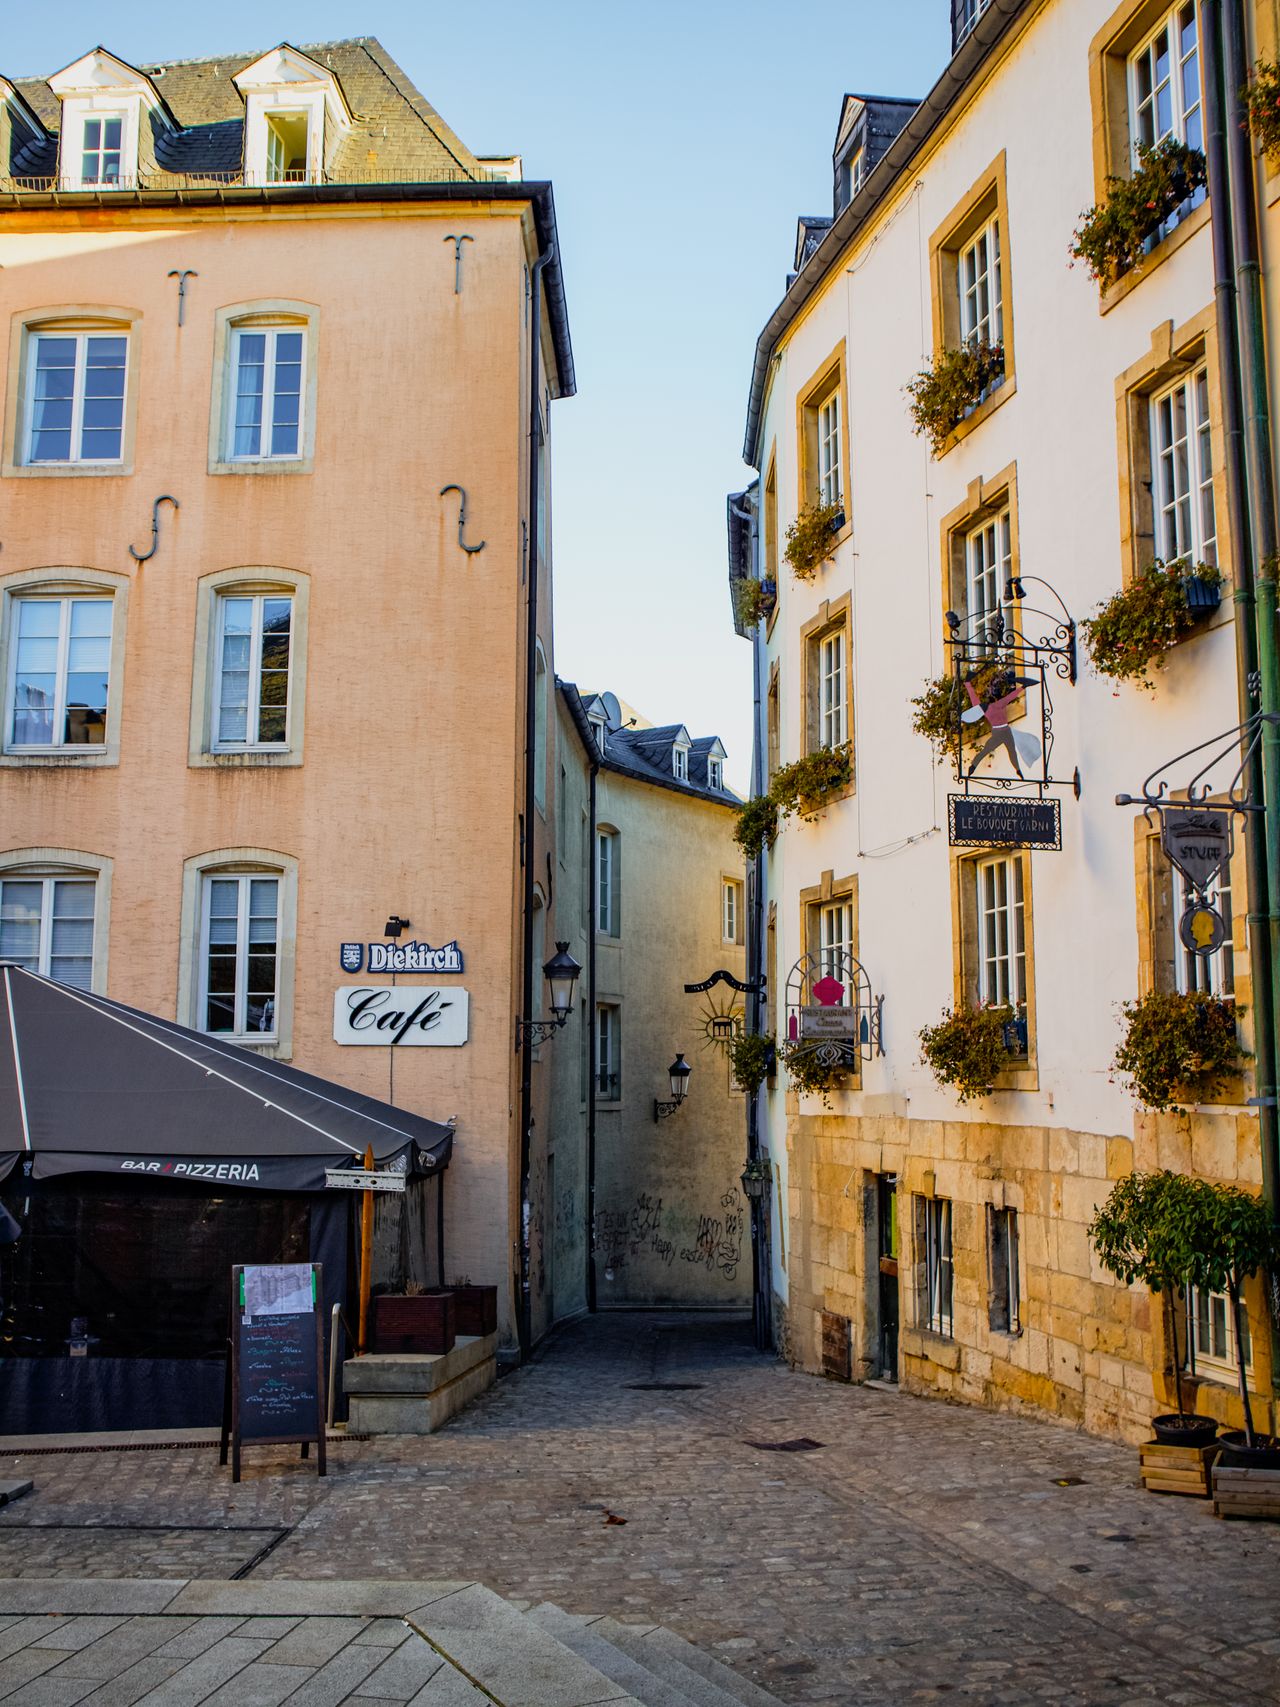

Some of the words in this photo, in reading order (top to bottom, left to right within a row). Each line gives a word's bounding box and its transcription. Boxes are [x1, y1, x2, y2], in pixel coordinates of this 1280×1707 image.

[973, 804, 1036, 818] RESTAURANT
[961, 817, 973, 829] LE
[977, 818, 1018, 831] BOUQUET
[1180, 846, 1221, 861] STUFF
[369, 941, 461, 971] Diekirch
[347, 989, 453, 1044] Café
[120, 1160, 161, 1172] BAR
[173, 1163, 259, 1181] PIZZERIA
